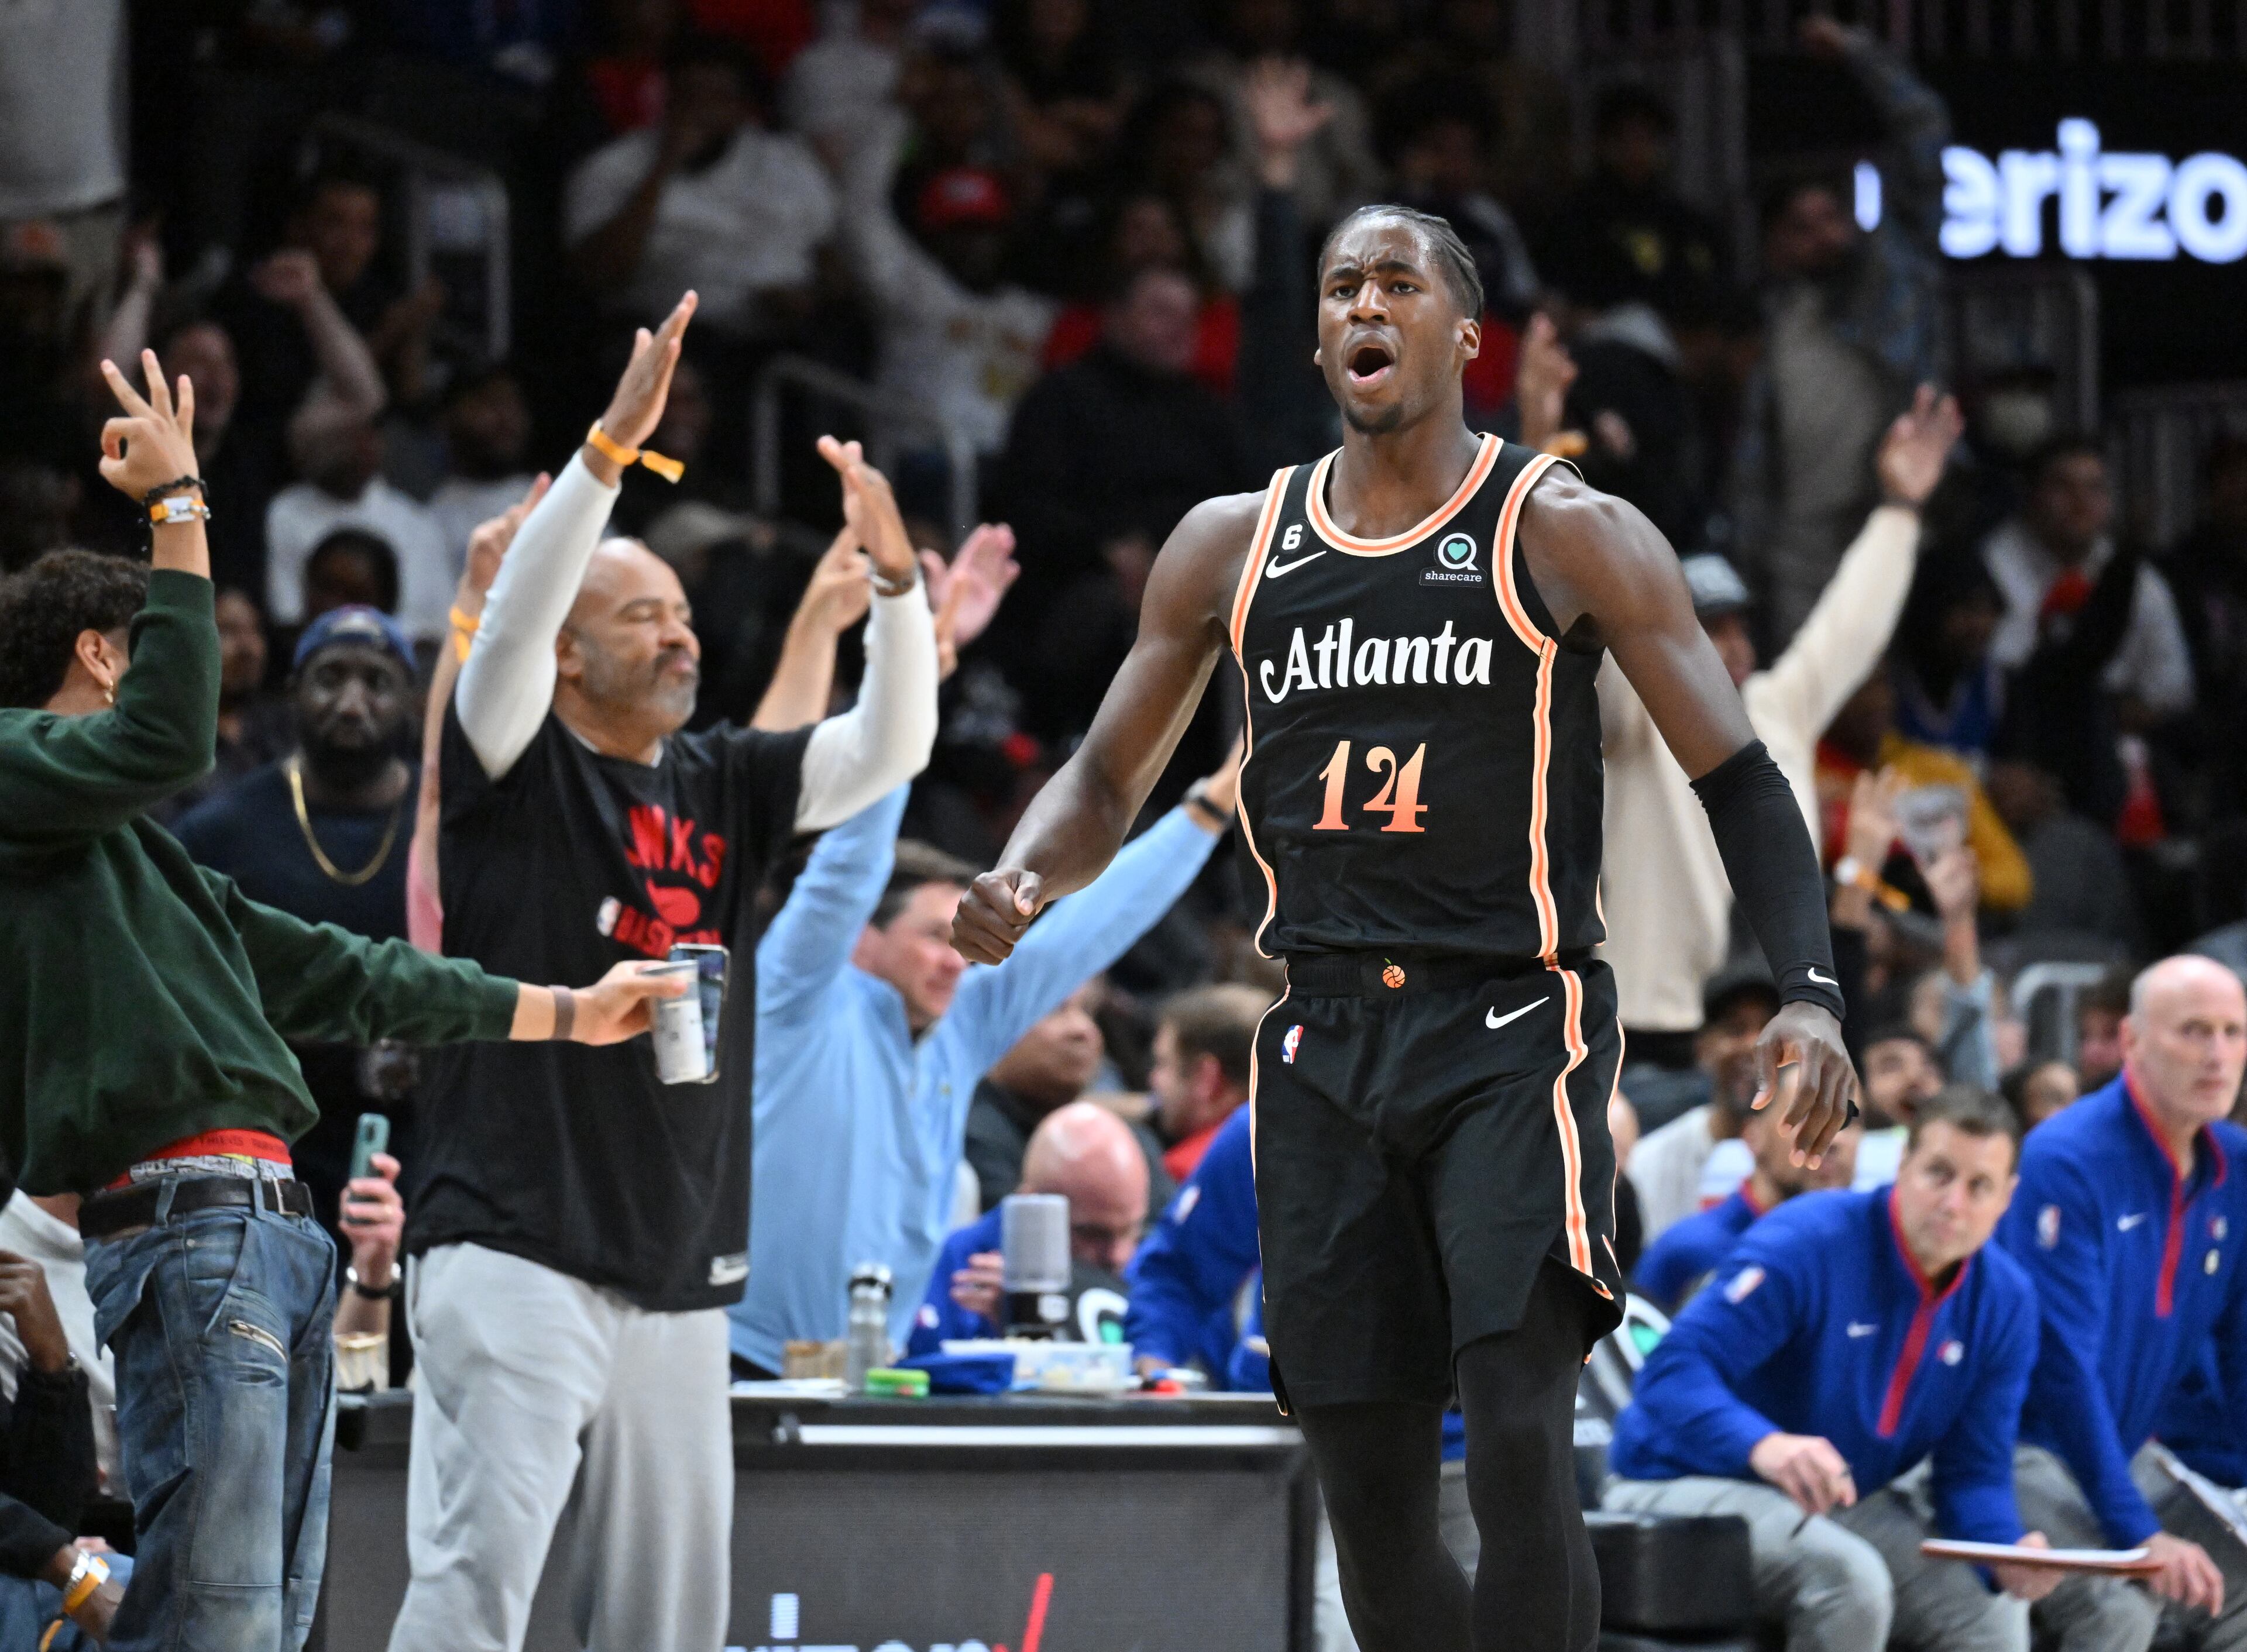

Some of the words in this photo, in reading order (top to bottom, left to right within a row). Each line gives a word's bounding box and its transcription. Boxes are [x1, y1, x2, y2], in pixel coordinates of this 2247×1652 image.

[1854, 118, 2246, 263] erizo
[1282, 524, 1303, 550] 6
[1425, 571, 1482, 582] sharecare
[1260, 618, 1493, 703] Atlanta
[1313, 741, 1428, 832] 14
